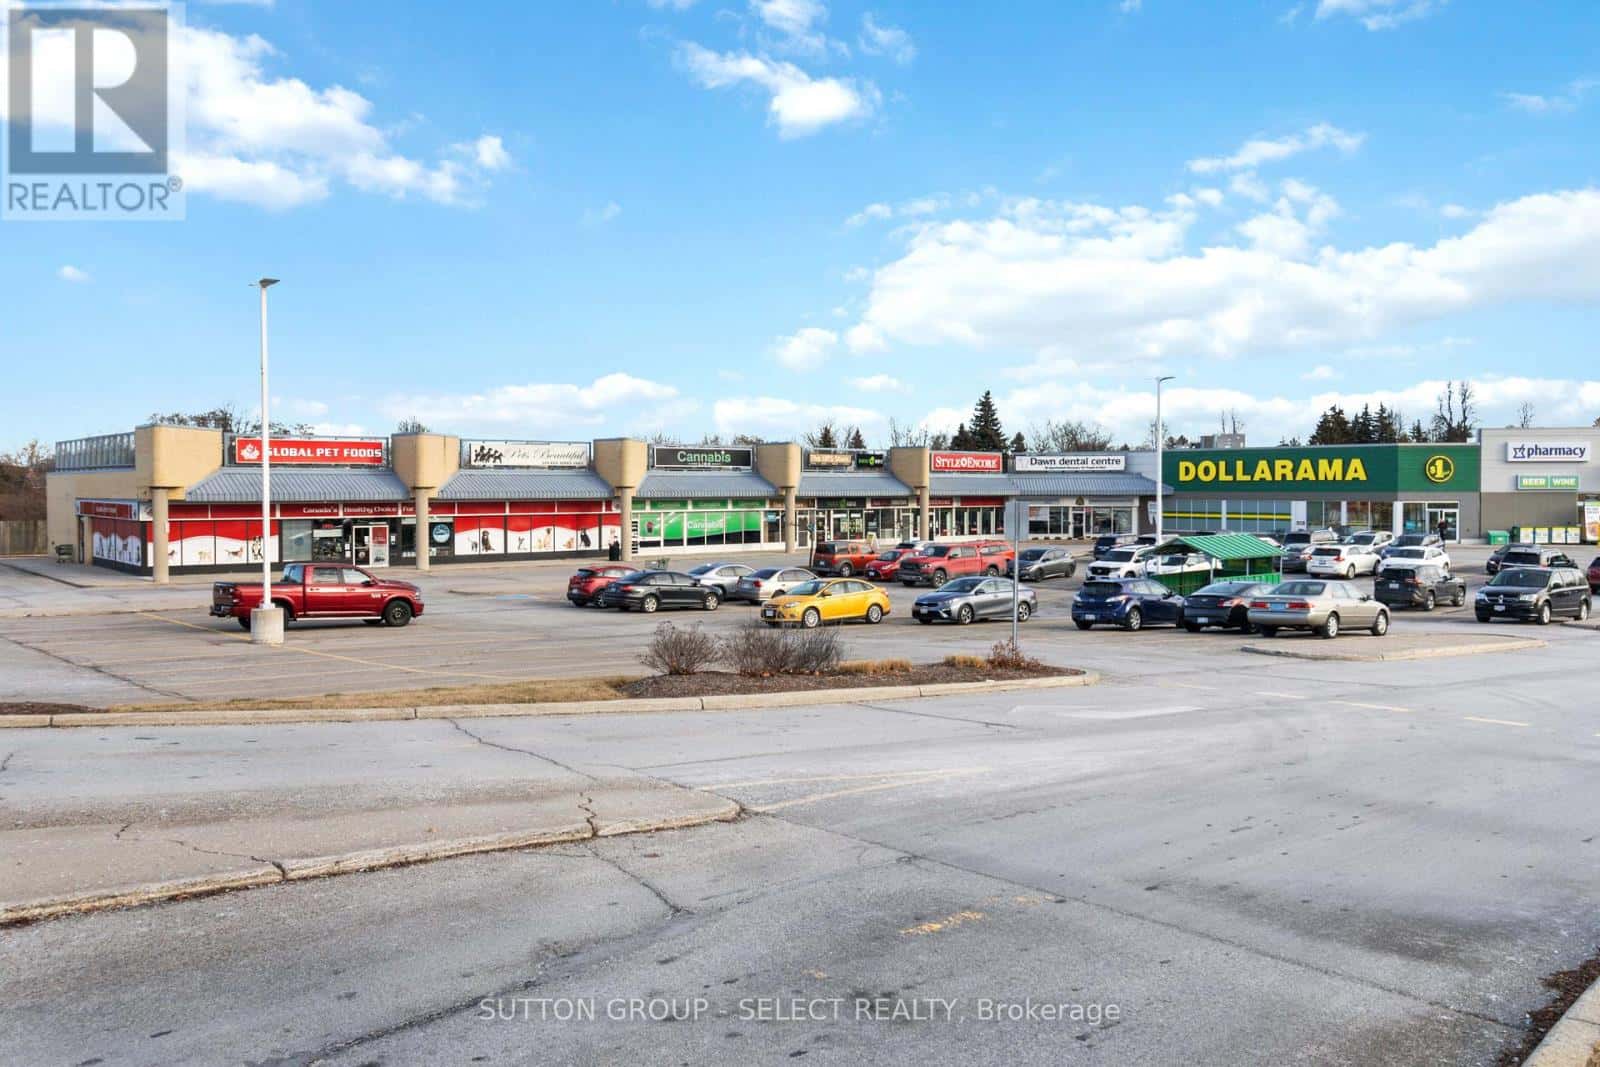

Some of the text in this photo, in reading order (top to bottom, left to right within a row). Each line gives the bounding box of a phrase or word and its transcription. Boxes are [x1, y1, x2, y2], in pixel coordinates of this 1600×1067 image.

[316, 447, 339, 457] PET
[343, 448, 382, 458] FOODS
[677, 450, 731, 463] Cannabis
[1527, 444, 1586, 458] pharmacy
[1030, 457, 1121, 466] Dawn dental centre
[1178, 459, 1367, 481] DOLLARAMA
[1522, 478, 1577, 488] BEER WINE
